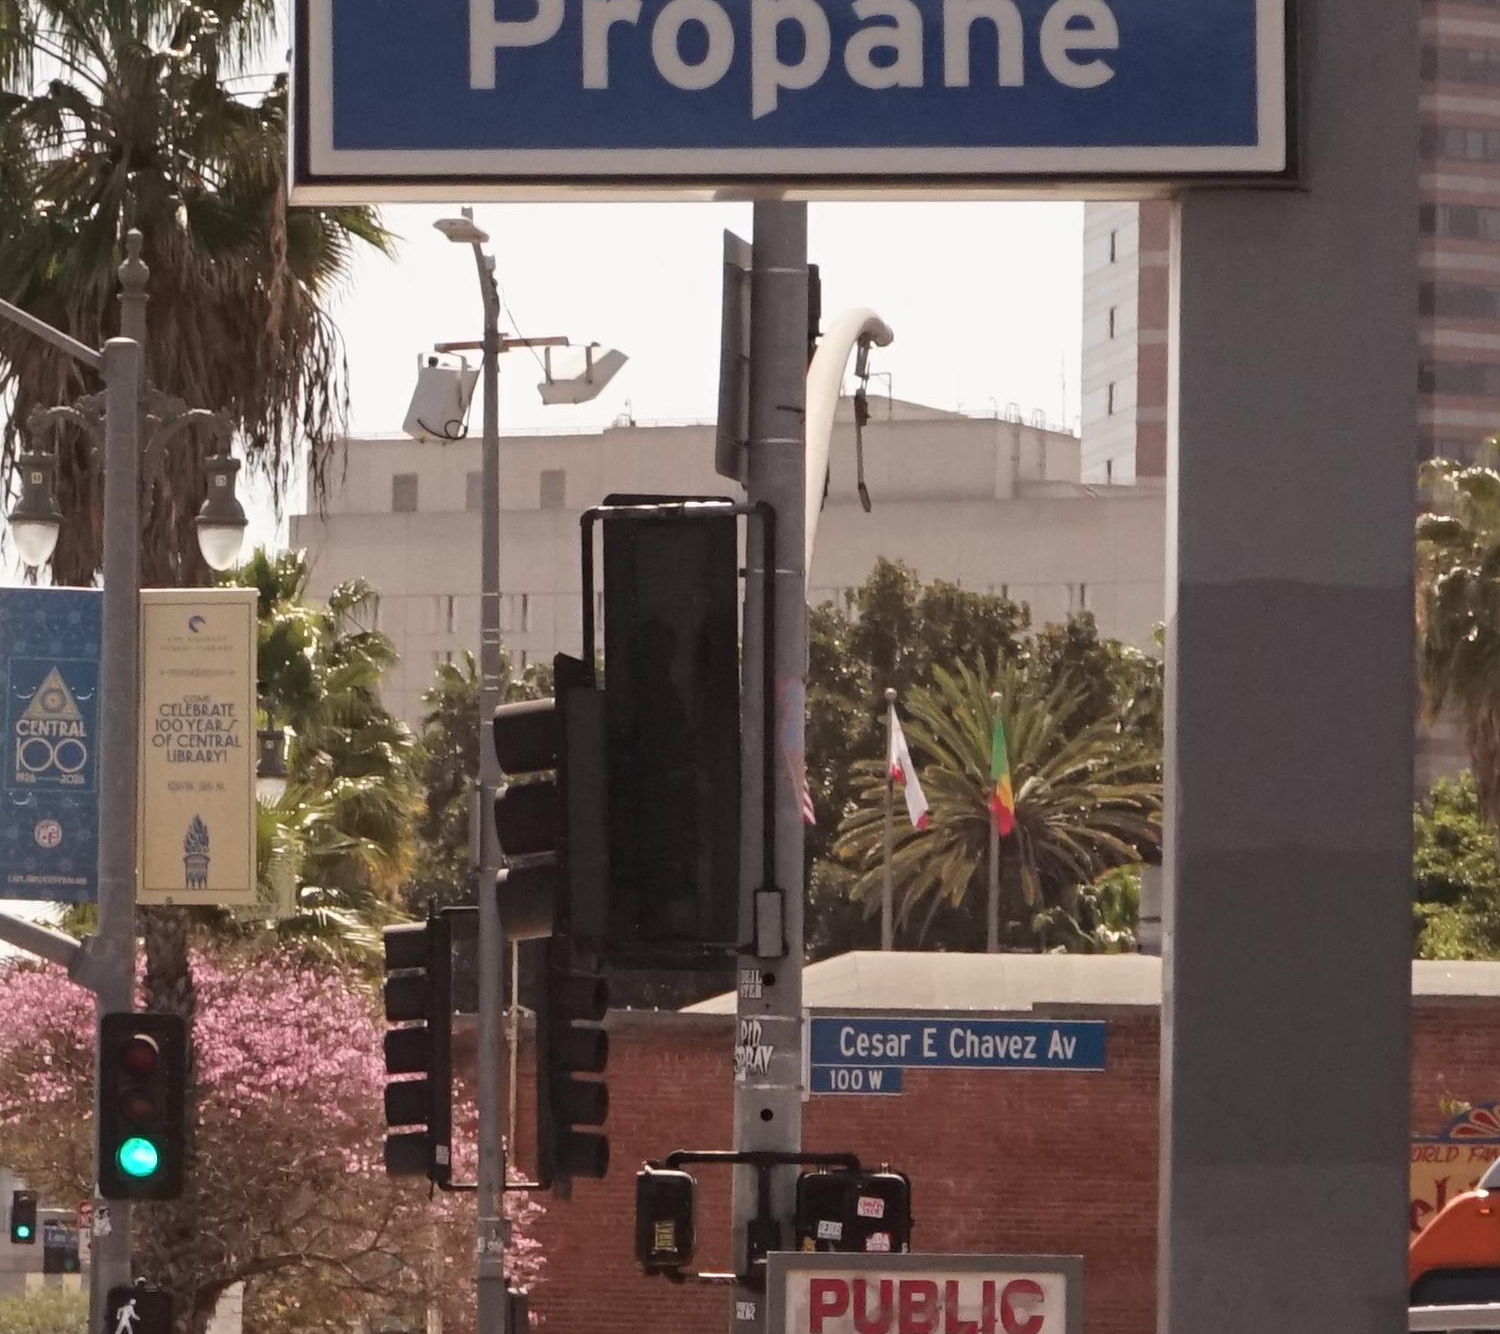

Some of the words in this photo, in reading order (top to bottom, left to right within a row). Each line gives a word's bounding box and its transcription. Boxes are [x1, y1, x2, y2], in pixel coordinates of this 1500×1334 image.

[159, 703, 235, 718] CELEBRATE
[15, 719, 88, 738] CENTRAL
[155, 718, 184, 733] 100
[187, 718, 240, 733] YEARS
[151, 734, 172, 748] OF
[176, 734, 243, 749] CENTRAL
[15, 737, 88, 773] 100
[166, 749, 228, 764] LIBRARY!
[839, 1027, 912, 1057] Cesar
[922, 1028, 938, 1058] E
[949, 1028, 1037, 1060] Chavez
[1047, 1030, 1077, 1060] Av
[829, 1069, 863, 1091] 100
[868, 1070, 884, 1091] W
[1410, 1145, 1460, 1164] ORLD
